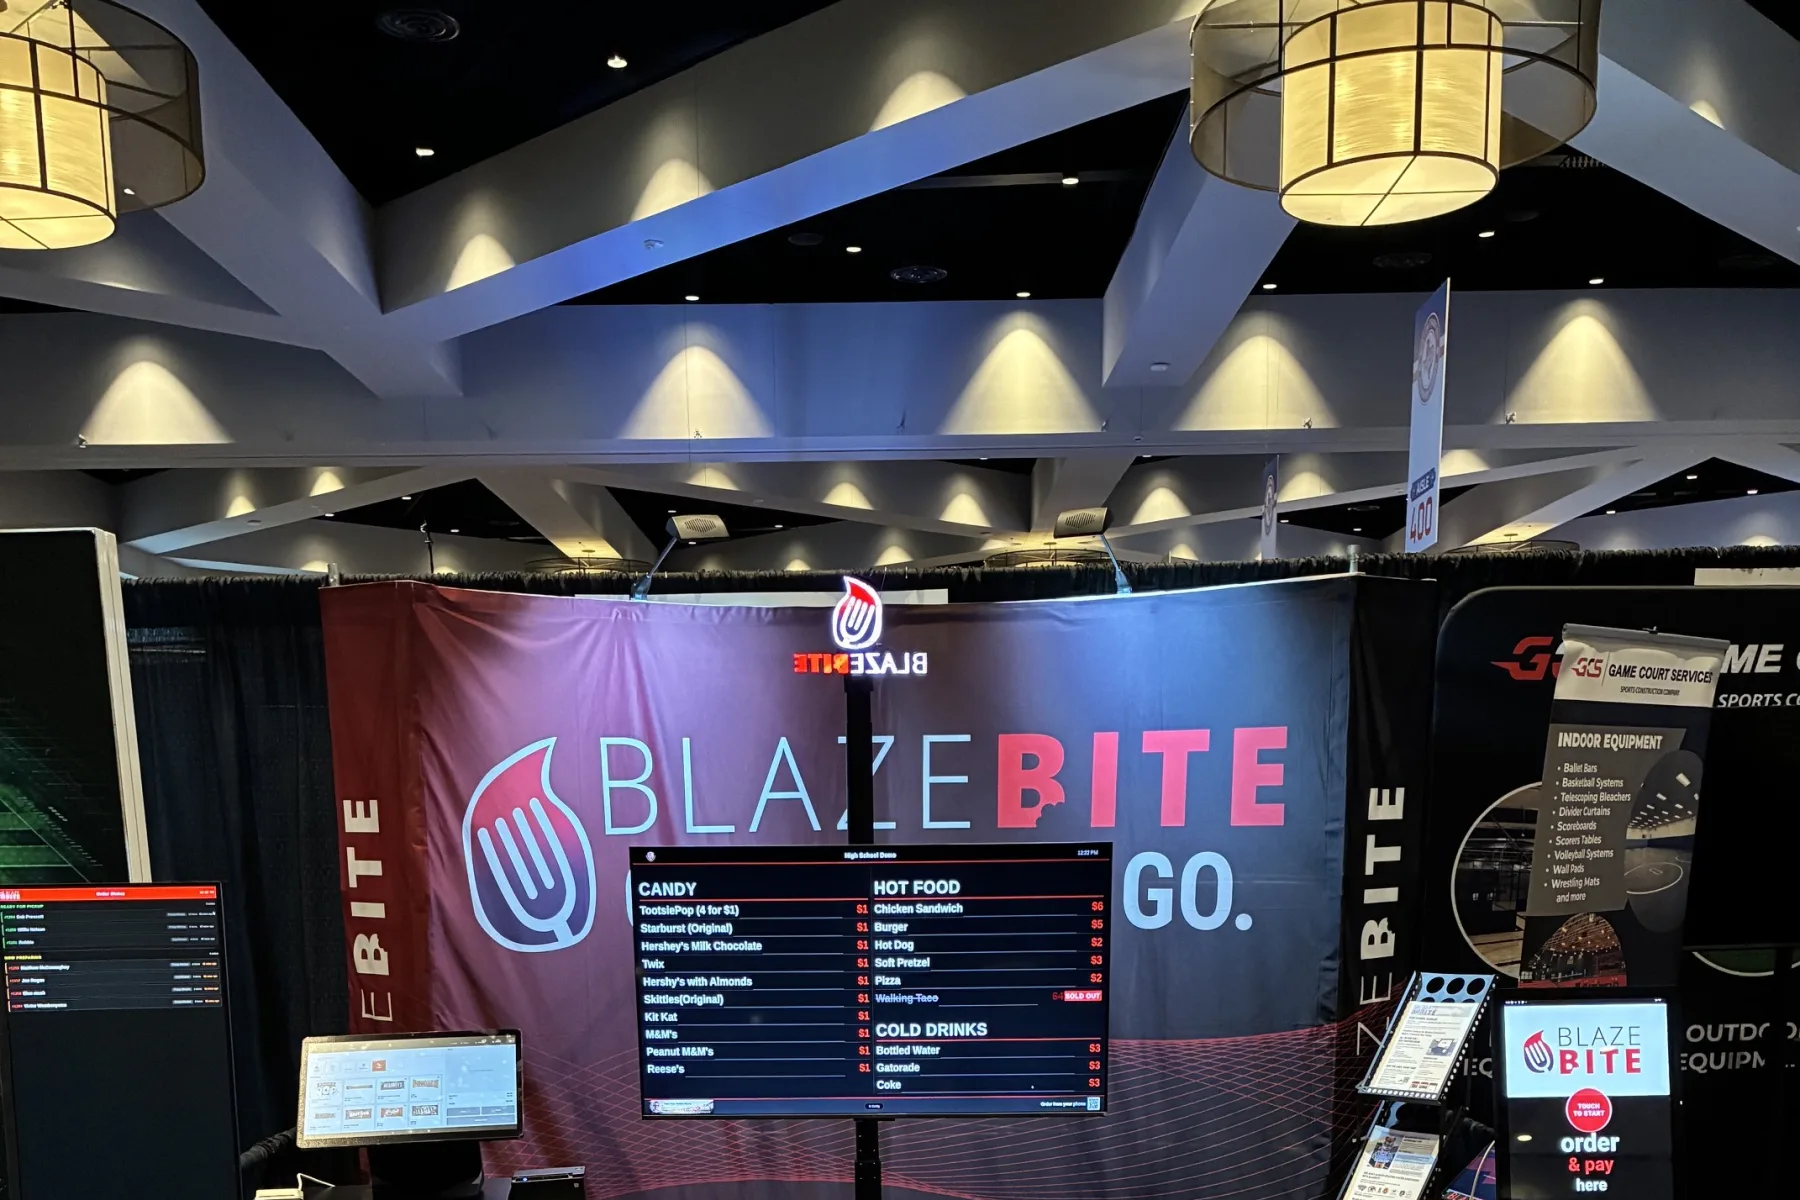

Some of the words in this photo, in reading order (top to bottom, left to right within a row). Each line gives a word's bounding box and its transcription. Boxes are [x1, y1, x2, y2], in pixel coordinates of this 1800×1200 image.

[1410, 496, 1432, 543] 400
[1719, 644, 1784, 673] ME
[1571, 657, 1603, 678] GCS
[1608, 664, 1637, 679] GAME
[1639, 666, 1668, 681] COURT
[1670, 668, 1713, 684] SERVICES
[1717, 693, 1783, 708] SPORTS
[1558, 732, 1601, 748] INDOOR
[1603, 734, 1663, 751] EQUIPMENT
[1564, 763, 1583, 773] Ballet
[1584, 763, 1598, 773] Bars
[1562, 778, 1595, 788] Basketball
[1596, 777, 1624, 788] Systems
[1560, 792, 1598, 803] Telescoping
[1599, 792, 1631, 802] Bleachers
[1559, 807, 1582, 817] Divider
[1583, 806, 1611, 816] Curtains
[1557, 821, 1597, 831] Scoreboards
[1556, 836, 1581, 846] Scorers
[1581, 835, 1602, 845] Tables
[844, 852, 859, 860] High
[859, 851, 879, 859] School
[880, 851, 897, 859] Demo
[1554, 849, 1585, 861] Volleyball
[1586, 848, 1614, 860] Systems
[1553, 864, 1570, 874] Wall
[1570, 863, 1585, 873] Pads
[638, 882, 697, 896] CANDY
[874, 880, 909, 895] HOT
[913, 880, 961, 895] FOOD
[1551, 877, 1583, 889] Wrestling
[1584, 876, 1600, 887] Mats
[1123, 851, 1252, 931] GO.
[1556, 892, 1569, 903] and
[1570, 892, 1587, 901] more
[343, 800, 392, 1021] EBITE
[639, 905, 694, 917] TootsiePop
[696, 905, 706, 917] (4
[707, 905, 722, 915] for
[723, 905, 739, 917] $1)
[856, 904, 868, 914] $1
[874, 904, 914, 914] Chicken
[916, 903, 963, 914] Sandwich
[1091, 901, 1103, 911] $6
[640, 924, 686, 934] Starburst
[688, 923, 733, 935] (Original)
[857, 922, 868, 932] $1
[874, 922, 908, 934] Burger
[1091, 919, 1103, 929] $5
[641, 941, 689, 953] Hershey's
[691, 941, 712, 951] Milk
[713, 941, 762, 951] Chocolate
[857, 940, 868, 950] $1
[875, 940, 892, 950] Hot
[894, 940, 914, 952] Dog
[1091, 937, 1103, 947] $2
[642, 959, 665, 969] Twix
[857, 958, 869, 967] $1
[875, 957, 895, 968] Soft
[897, 957, 930, 968] Pretzel
[1091, 955, 1102, 965] $3
[643, 976, 686, 988] Hershy's
[687, 976, 708, 986] with
[709, 976, 753, 986] Almonds
[858, 976, 869, 985] $1
[875, 976, 901, 986] Pizza
[1090, 973, 1102, 983] $2
[644, 994, 724, 1006] Skittles(Original)
[858, 993, 869, 1003] $1
[875, 993, 914, 1004] Walking
[915, 993, 939, 1003] Taco
[1065, 992, 1085, 1000] SOLD
[1085, 992, 1101, 1000] OUT
[645, 1012, 659, 1022] Kit
[660, 1012, 678, 1022] Kat
[858, 1011, 870, 1020] $1
[645, 1029, 678, 1039] M&M's
[858, 1028, 870, 1038] $1
[876, 1023, 921, 1037] COLD
[926, 1022, 988, 1036] DRINKS
[1685, 1021, 1799, 1043] OUTD
[1559, 1026, 1641, 1047] BLAZE
[647, 1047, 680, 1057] Peanut
[682, 1046, 714, 1057] M&M's
[859, 1046, 870, 1055] $1
[876, 1045, 911, 1055] Bottled
[912, 1045, 940, 1055] Water
[1089, 1044, 1100, 1053] $3
[876, 1063, 920, 1072] Gatorade
[1089, 1061, 1100, 1070] $3
[1559, 1048, 1641, 1075] BITE
[1680, 1051, 1768, 1074] EQUIPM
[647, 1064, 685, 1074] Reese's
[859, 1063, 870, 1073] $1
[877, 1080, 901, 1089] Coke
[1088, 1078, 1100, 1088] $3
[1561, 1132, 1620, 1152] order
[1568, 1157, 1580, 1172] &
[1585, 1159, 1614, 1175] pay
[1576, 1178, 1608, 1192] here
